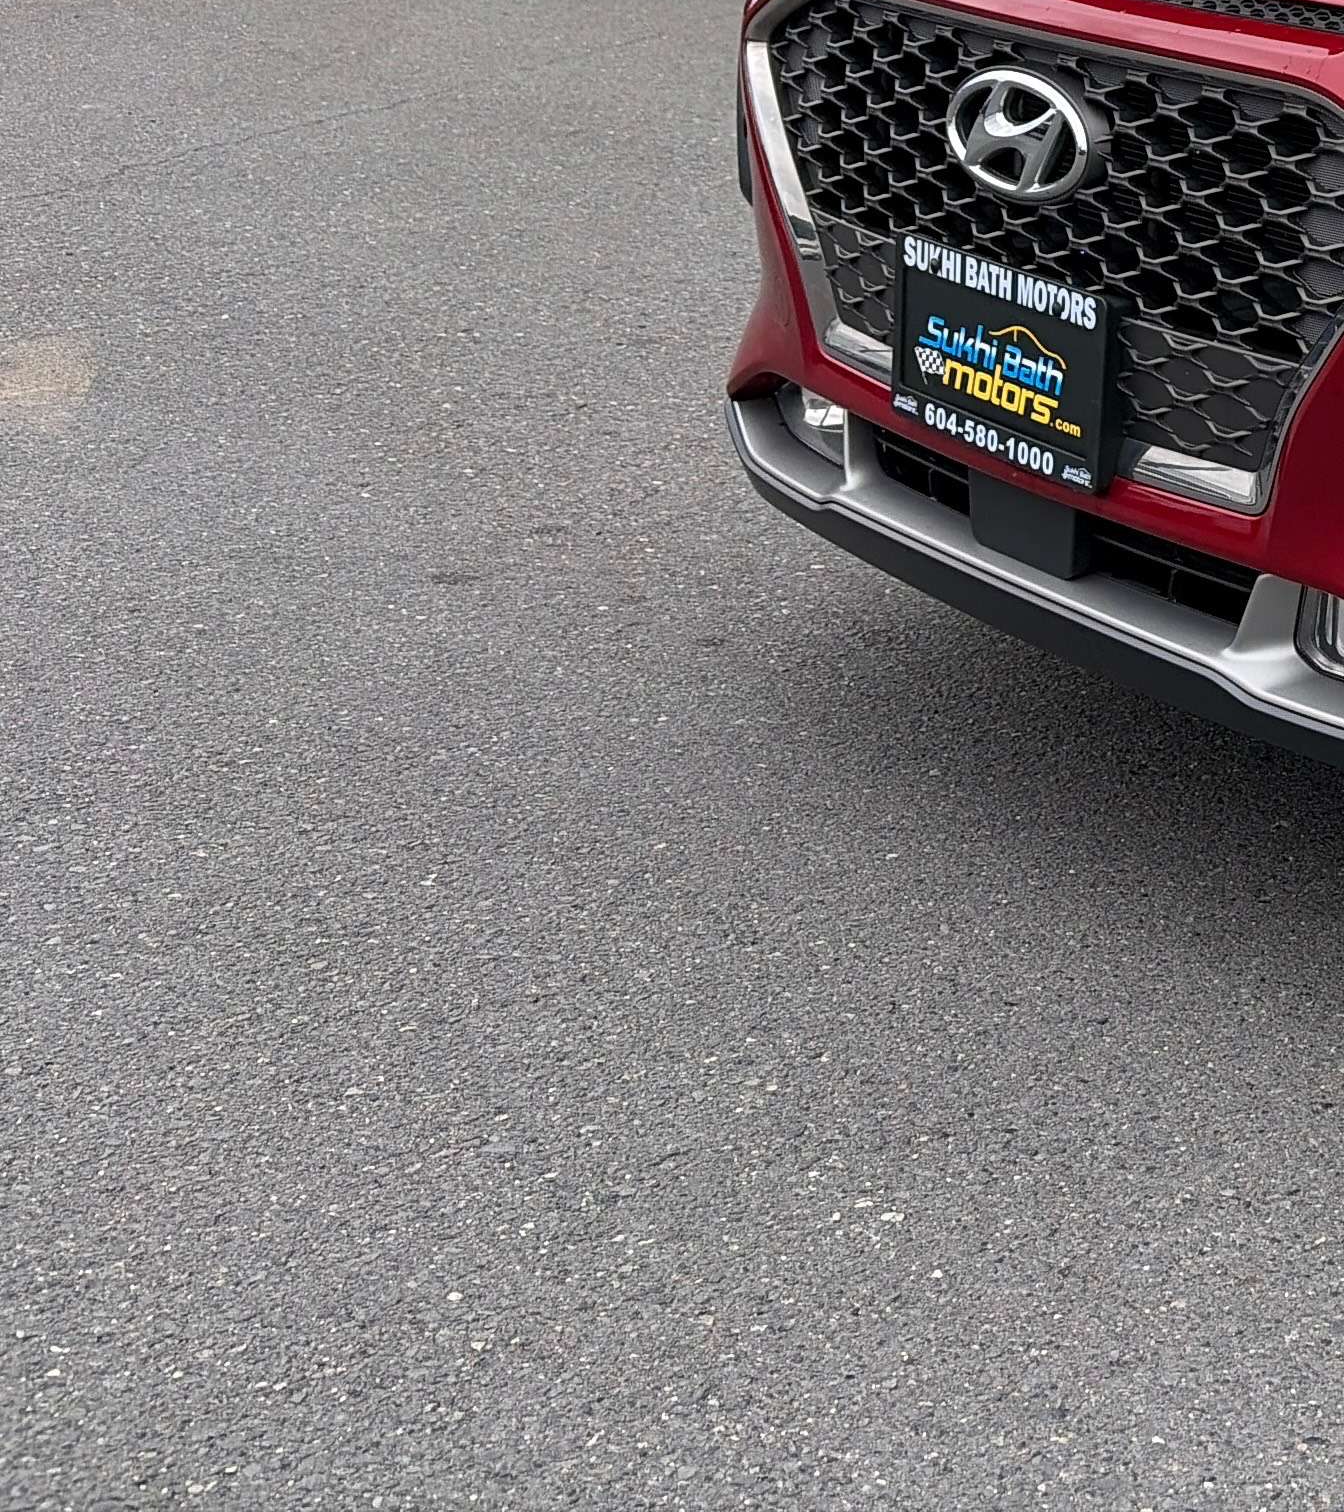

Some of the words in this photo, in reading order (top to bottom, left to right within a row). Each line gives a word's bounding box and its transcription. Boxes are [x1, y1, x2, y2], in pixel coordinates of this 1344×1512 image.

[903, 235, 962, 284] SUKHI
[965, 255, 1013, 302] BATH
[1016, 273, 1097, 330] MOTORS
[918, 315, 998, 371] Sukhi
[1002, 343, 1064, 396] Bath
[924, 402, 1054, 476] 604-580-1000
